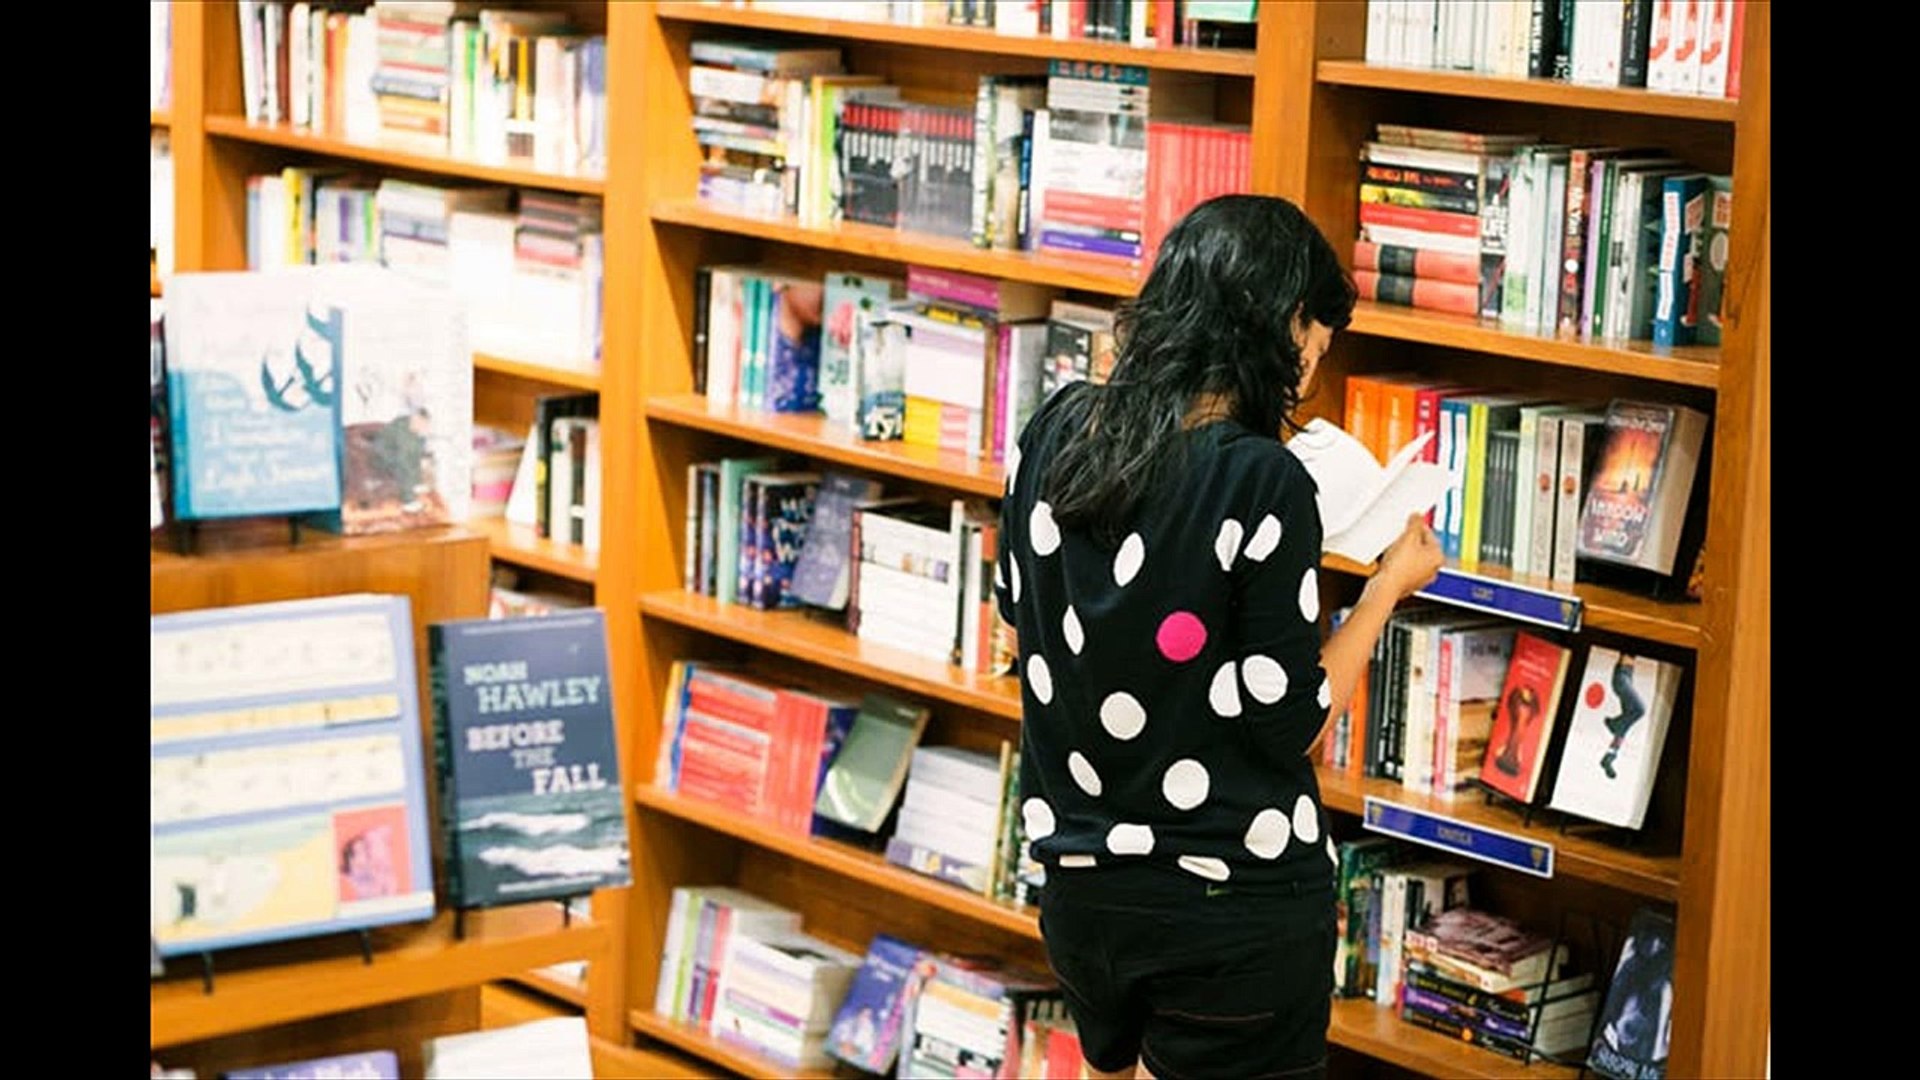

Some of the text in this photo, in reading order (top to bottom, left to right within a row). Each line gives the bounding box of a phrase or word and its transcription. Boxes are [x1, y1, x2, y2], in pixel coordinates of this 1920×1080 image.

[463, 660, 528, 686] NOAH
[477, 674, 602, 714] HAWLEY
[466, 719, 566, 752] BEFORE
[510, 747, 556, 769] THE
[531, 761, 607, 796] FALL
